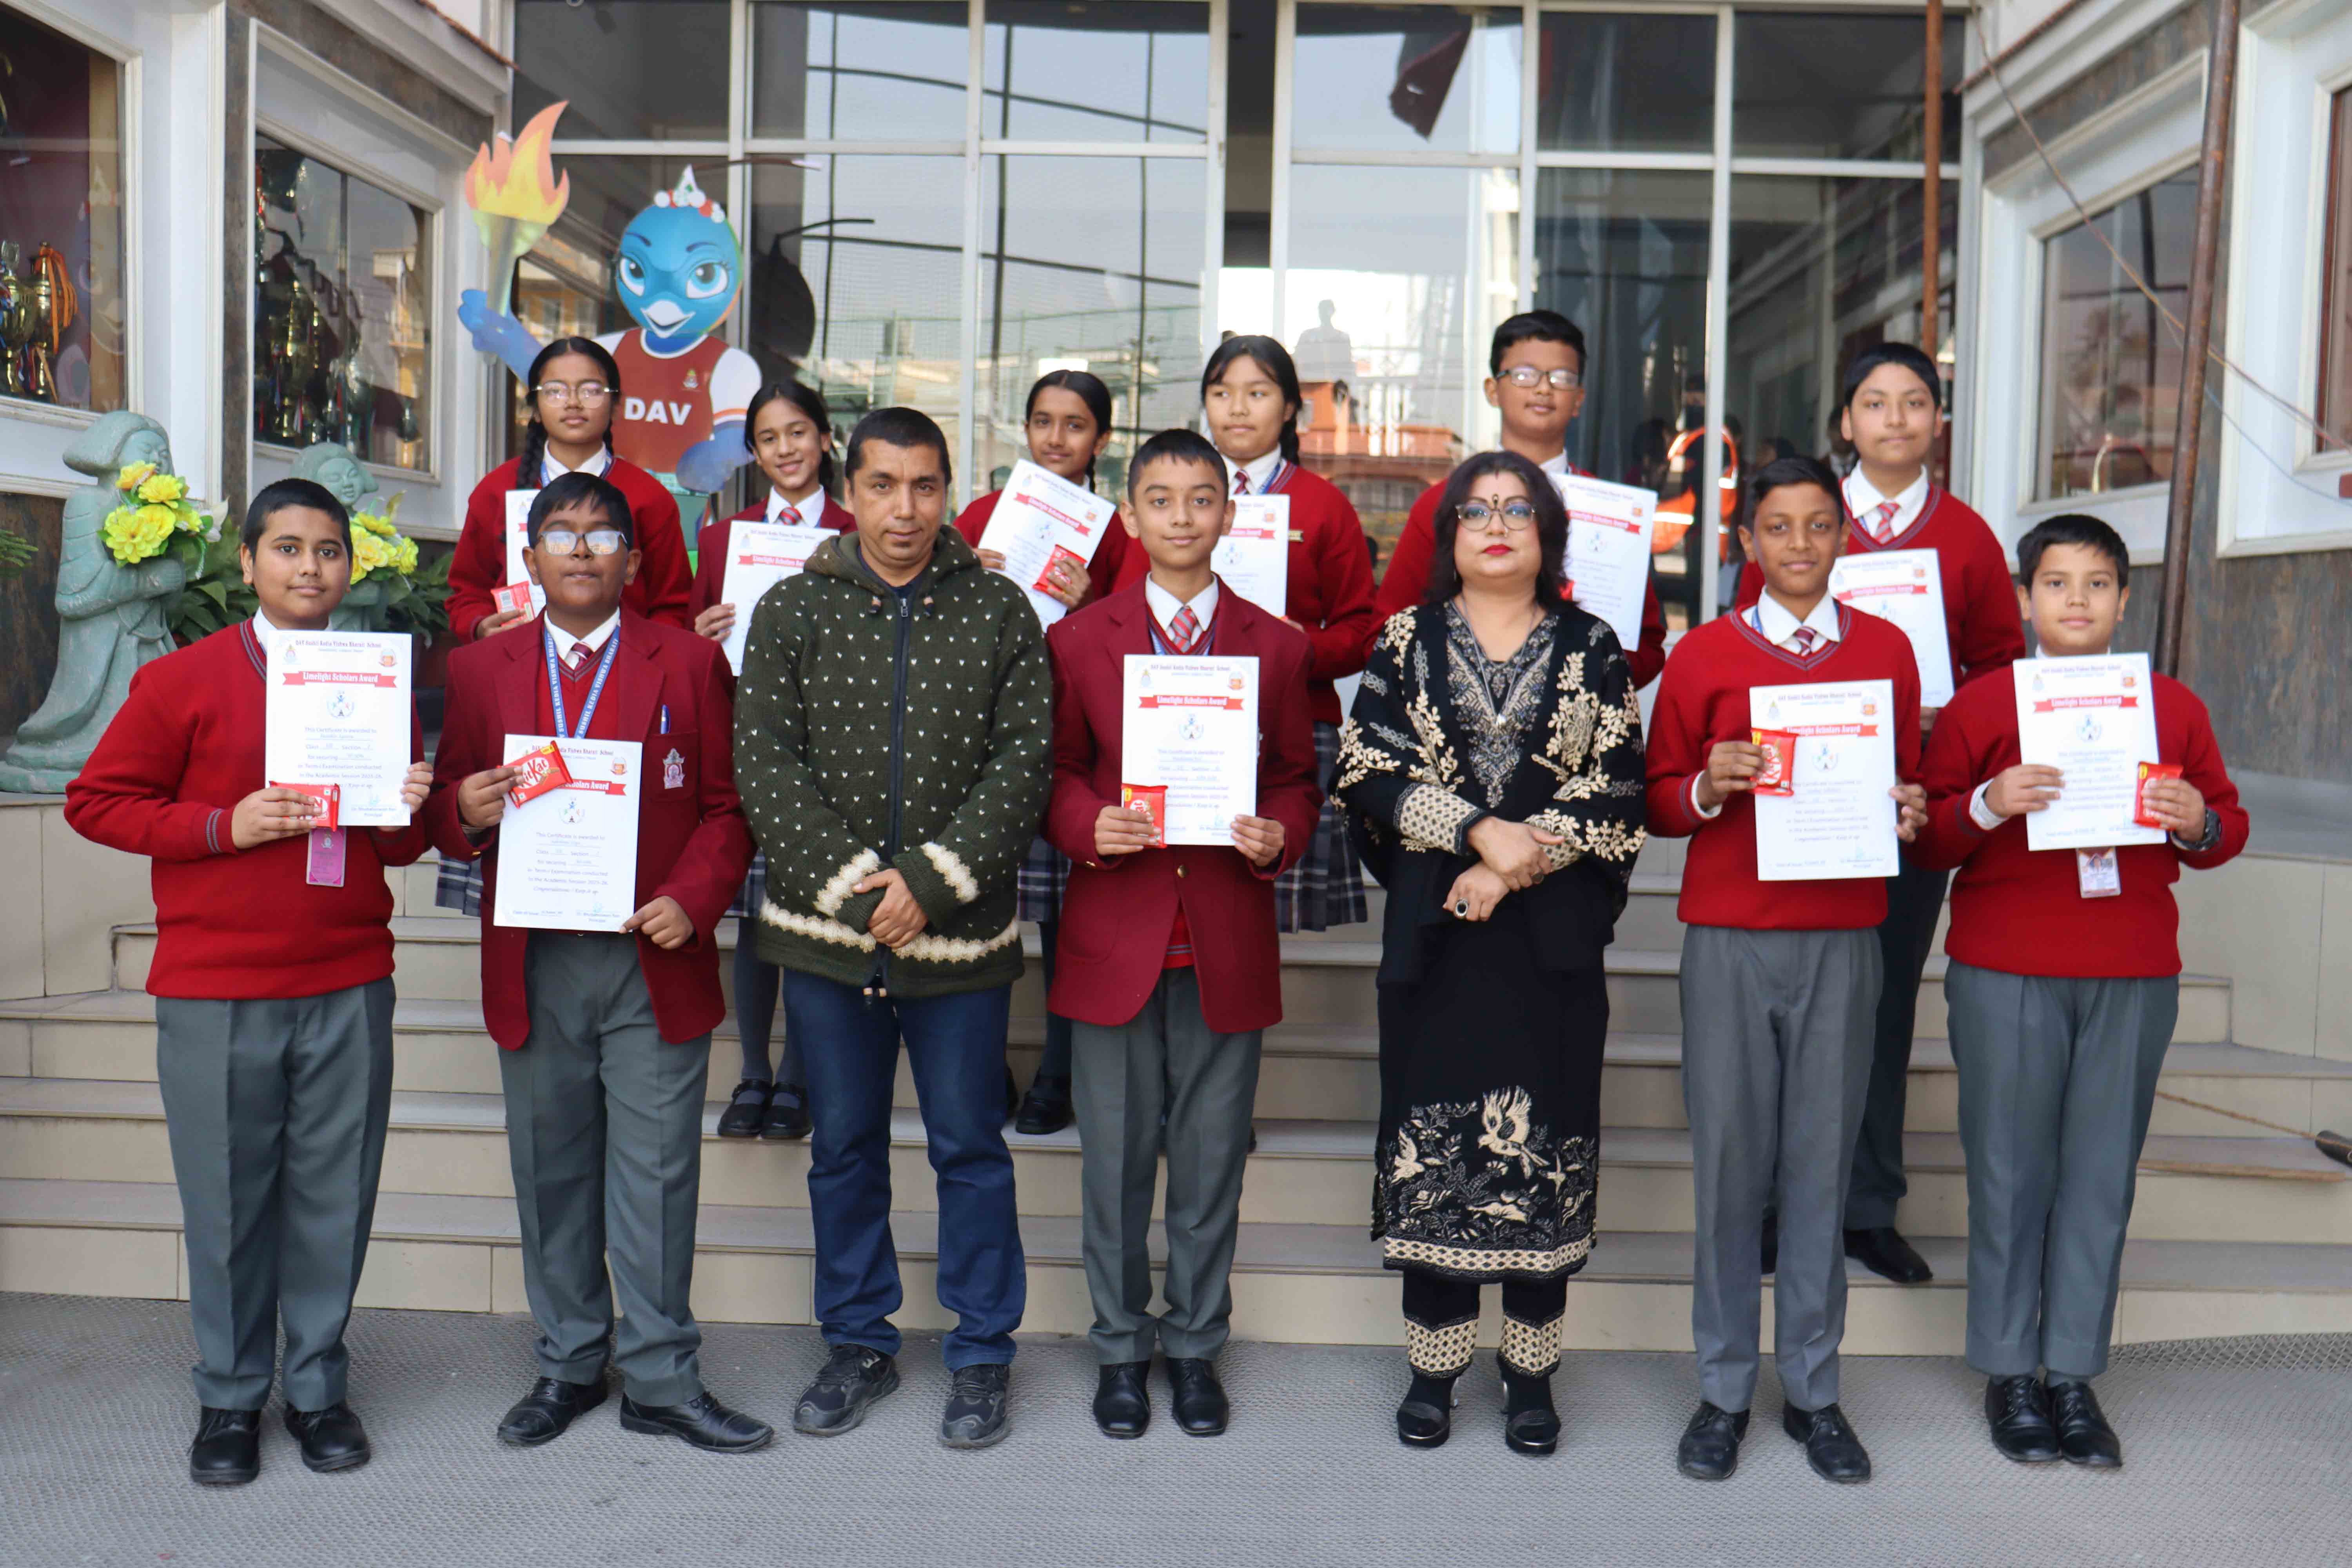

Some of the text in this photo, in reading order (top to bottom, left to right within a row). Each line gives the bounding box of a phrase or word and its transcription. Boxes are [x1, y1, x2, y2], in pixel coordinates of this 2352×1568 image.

[624, 397, 692, 425] DAV
[303, 672, 331, 682] Limelight
[332, 673, 358, 681] Scholars
[579, 639, 619, 734] SUSHIL KEDIA VISHWA BHARATI
[590, 782, 609, 790] Award
